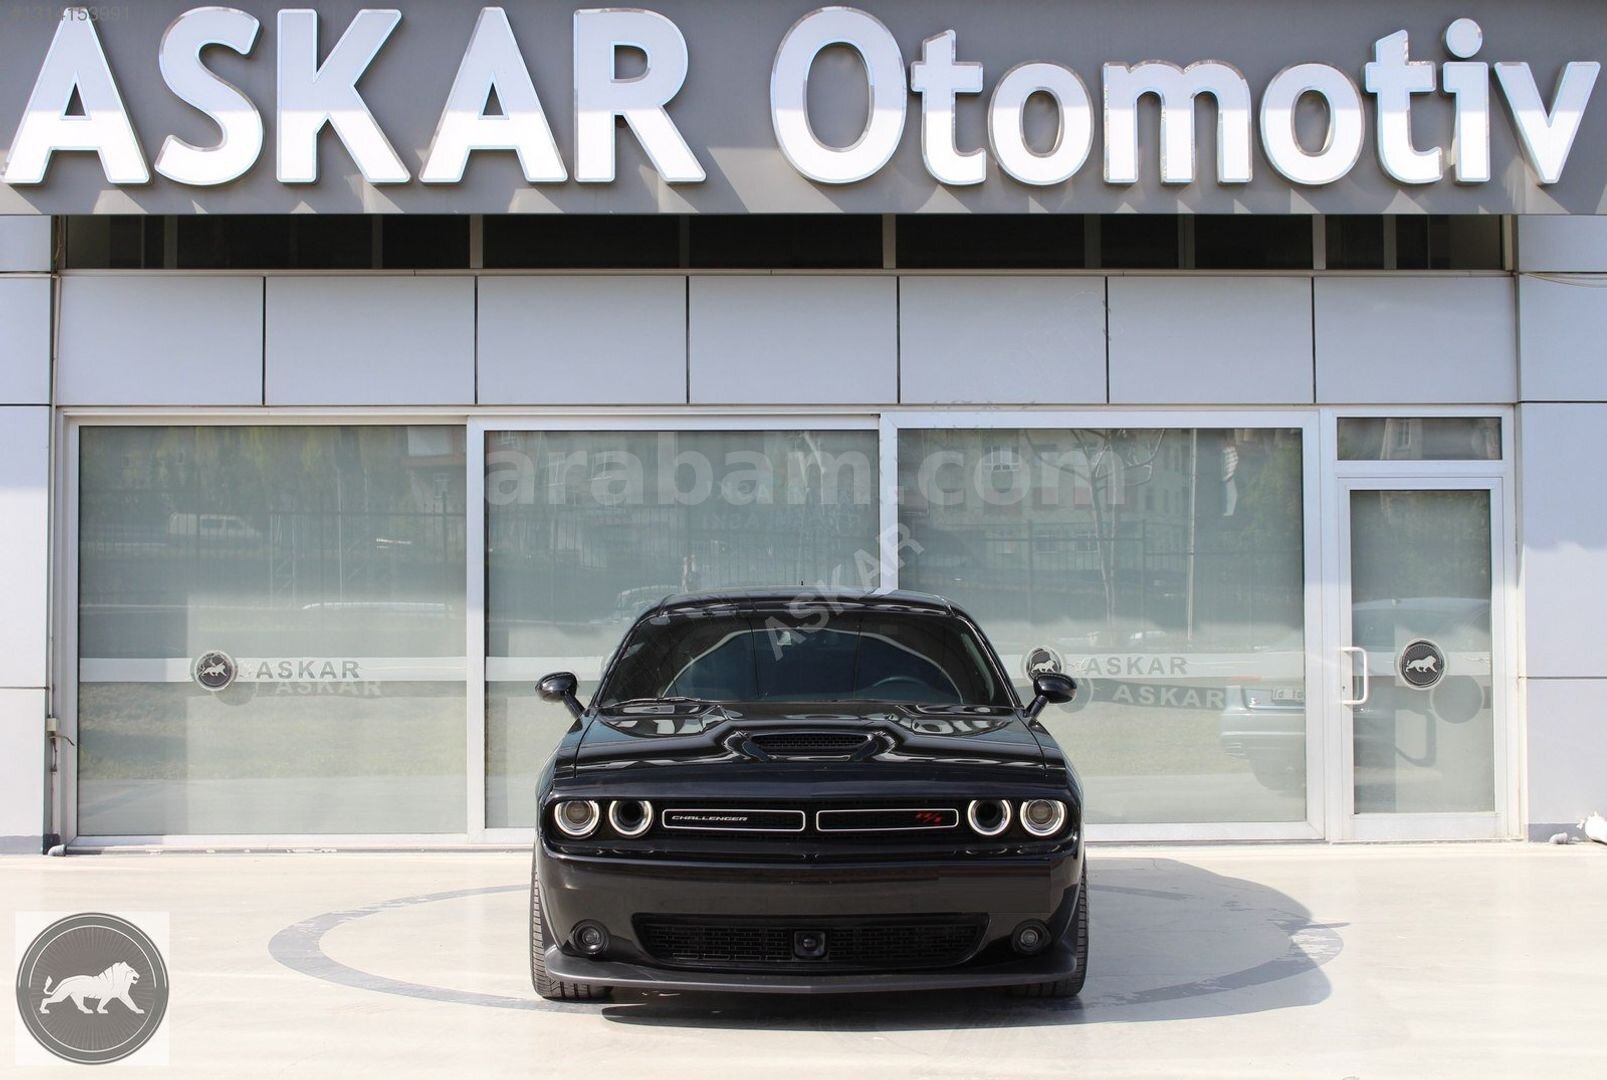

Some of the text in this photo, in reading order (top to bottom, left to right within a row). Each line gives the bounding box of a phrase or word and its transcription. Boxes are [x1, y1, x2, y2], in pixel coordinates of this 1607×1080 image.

[3, 6, 1601, 187] ASKAR Otomotiv
[255, 660, 361, 680] ASKAR
[1085, 656, 1188, 676] ASKAR
[1112, 683, 1225, 709] ASKAR
